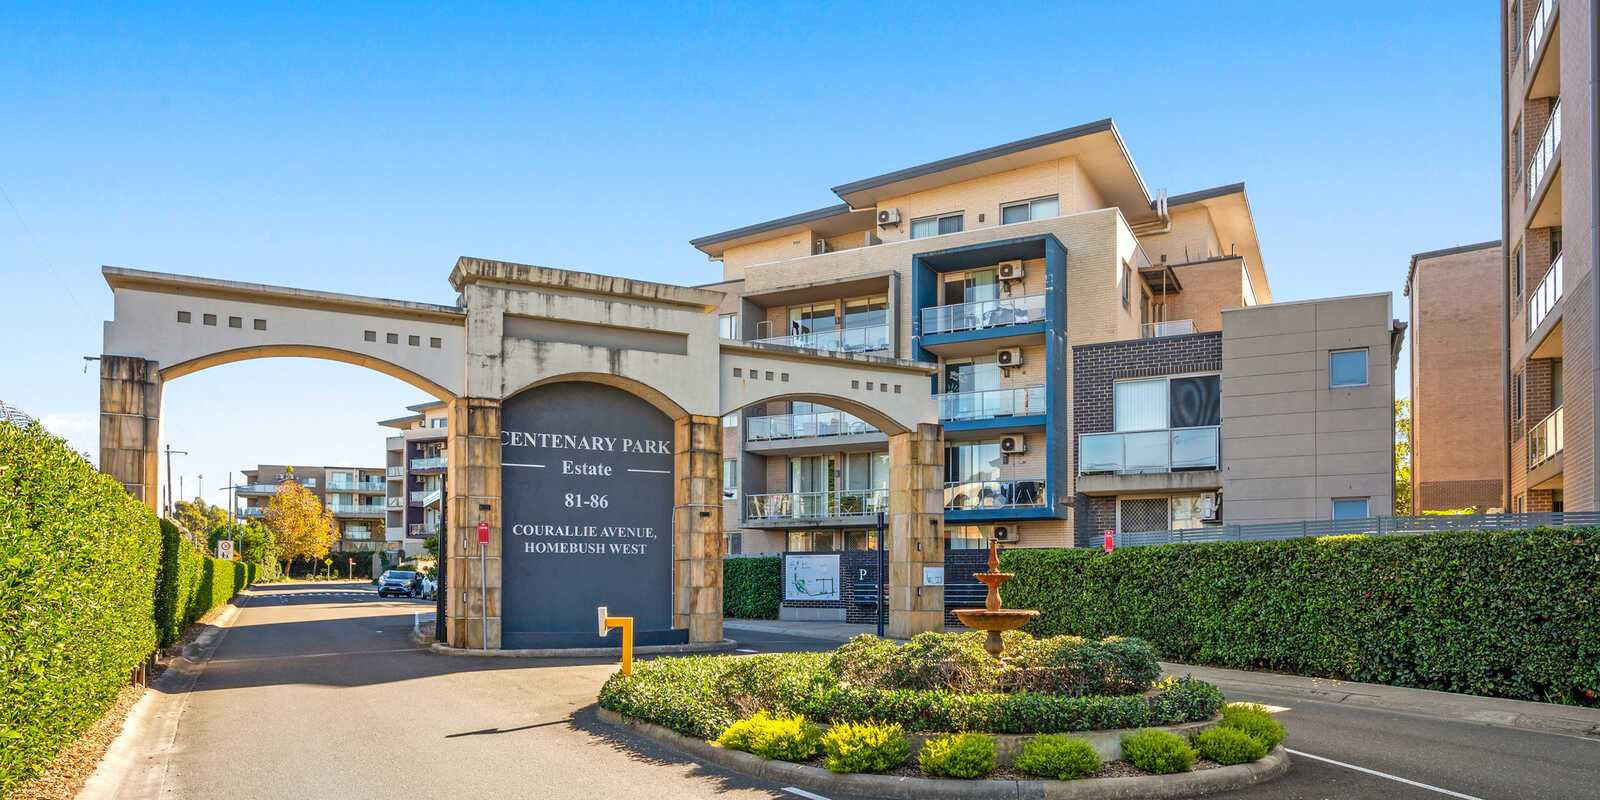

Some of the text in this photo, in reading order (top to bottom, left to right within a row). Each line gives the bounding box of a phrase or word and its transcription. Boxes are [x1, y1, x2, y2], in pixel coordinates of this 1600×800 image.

[501, 430, 672, 455] CENTENARY PARK
[562, 459, 613, 476] Estate
[564, 493, 609, 509] 81-86
[512, 524, 657, 540] COURALLIE AVENUE,
[524, 542, 648, 555] HOMEBUSH WEST
[859, 568, 867, 580] P
